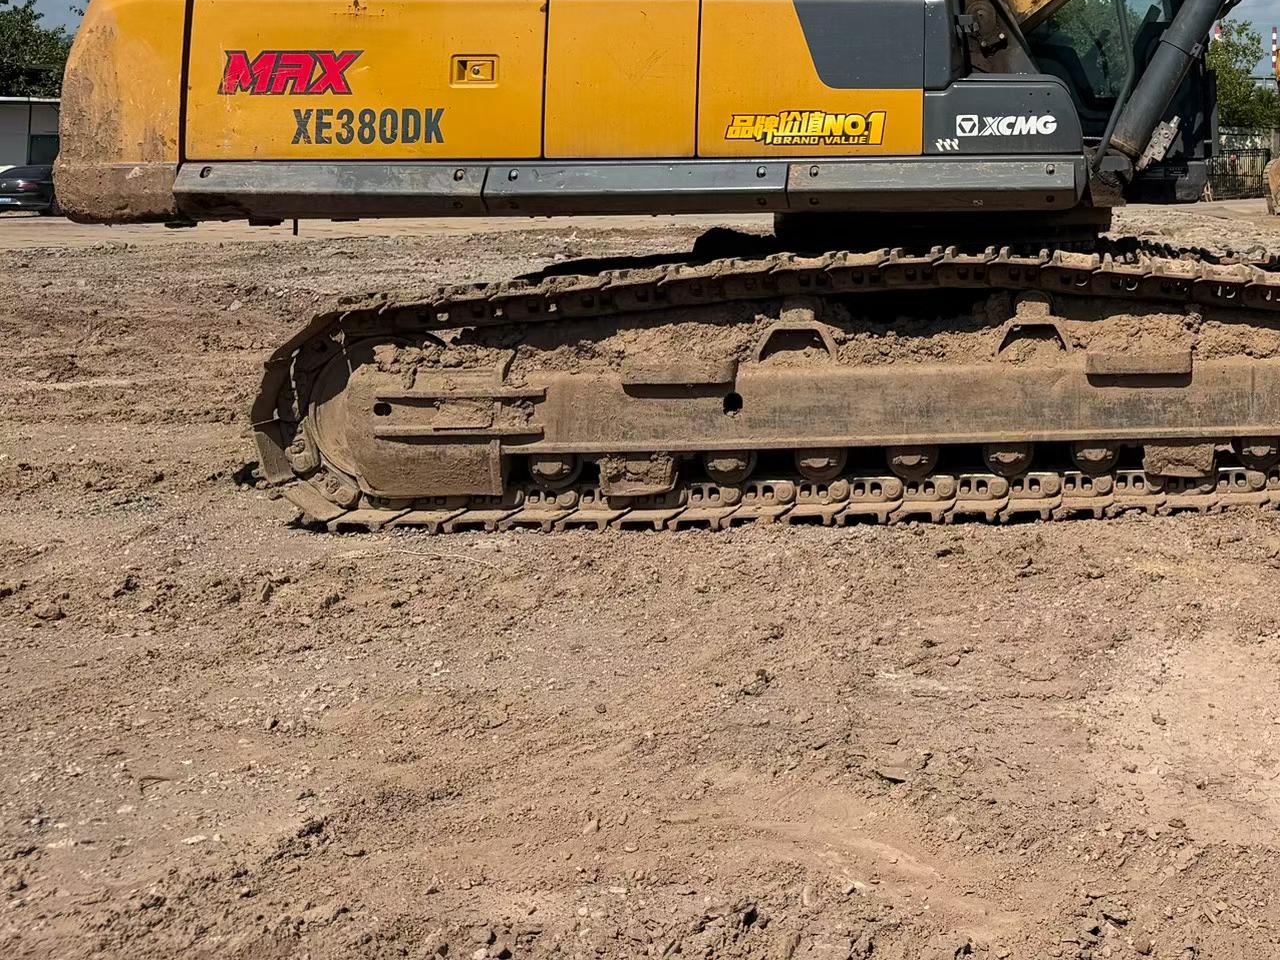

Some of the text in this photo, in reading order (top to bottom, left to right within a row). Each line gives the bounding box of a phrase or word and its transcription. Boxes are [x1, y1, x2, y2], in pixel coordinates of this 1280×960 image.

[217, 50, 364, 95] MAX
[291, 108, 445, 145] XE380DK
[978, 115, 1058, 136] XCMG
[773, 136, 868, 145] BRAND VALUE
